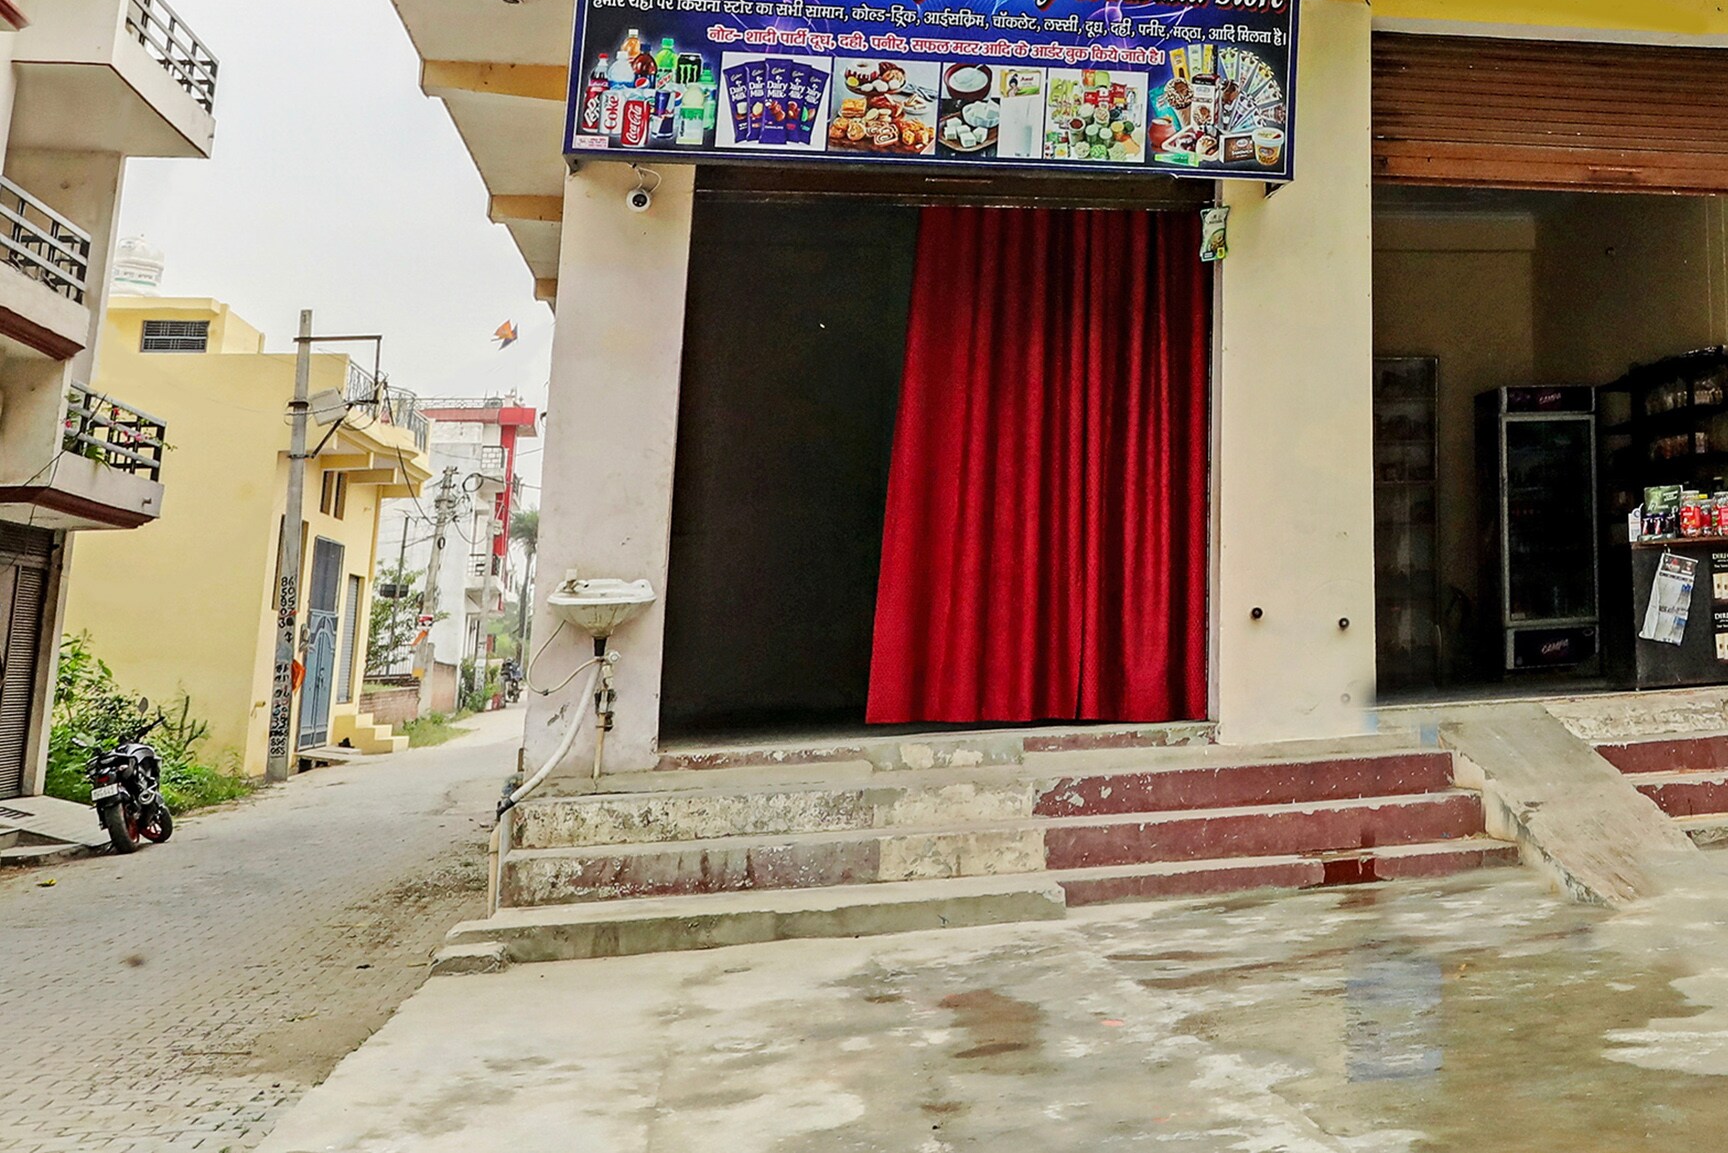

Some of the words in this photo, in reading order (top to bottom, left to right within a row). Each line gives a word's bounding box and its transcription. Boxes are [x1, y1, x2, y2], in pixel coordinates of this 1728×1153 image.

[755, 0, 773, 14] का
[776, 0, 804, 17] सभी
[1209, 25, 1235, 43] आदि
[1238, 25, 1271, 44] मिलता
[744, 28, 777, 44] शादी
[951, 42, 979, 54] मटर
[981, 40, 1011, 57] आदि
[767, 81, 788, 91] Dairy
[767, 90, 786, 98] Milk
